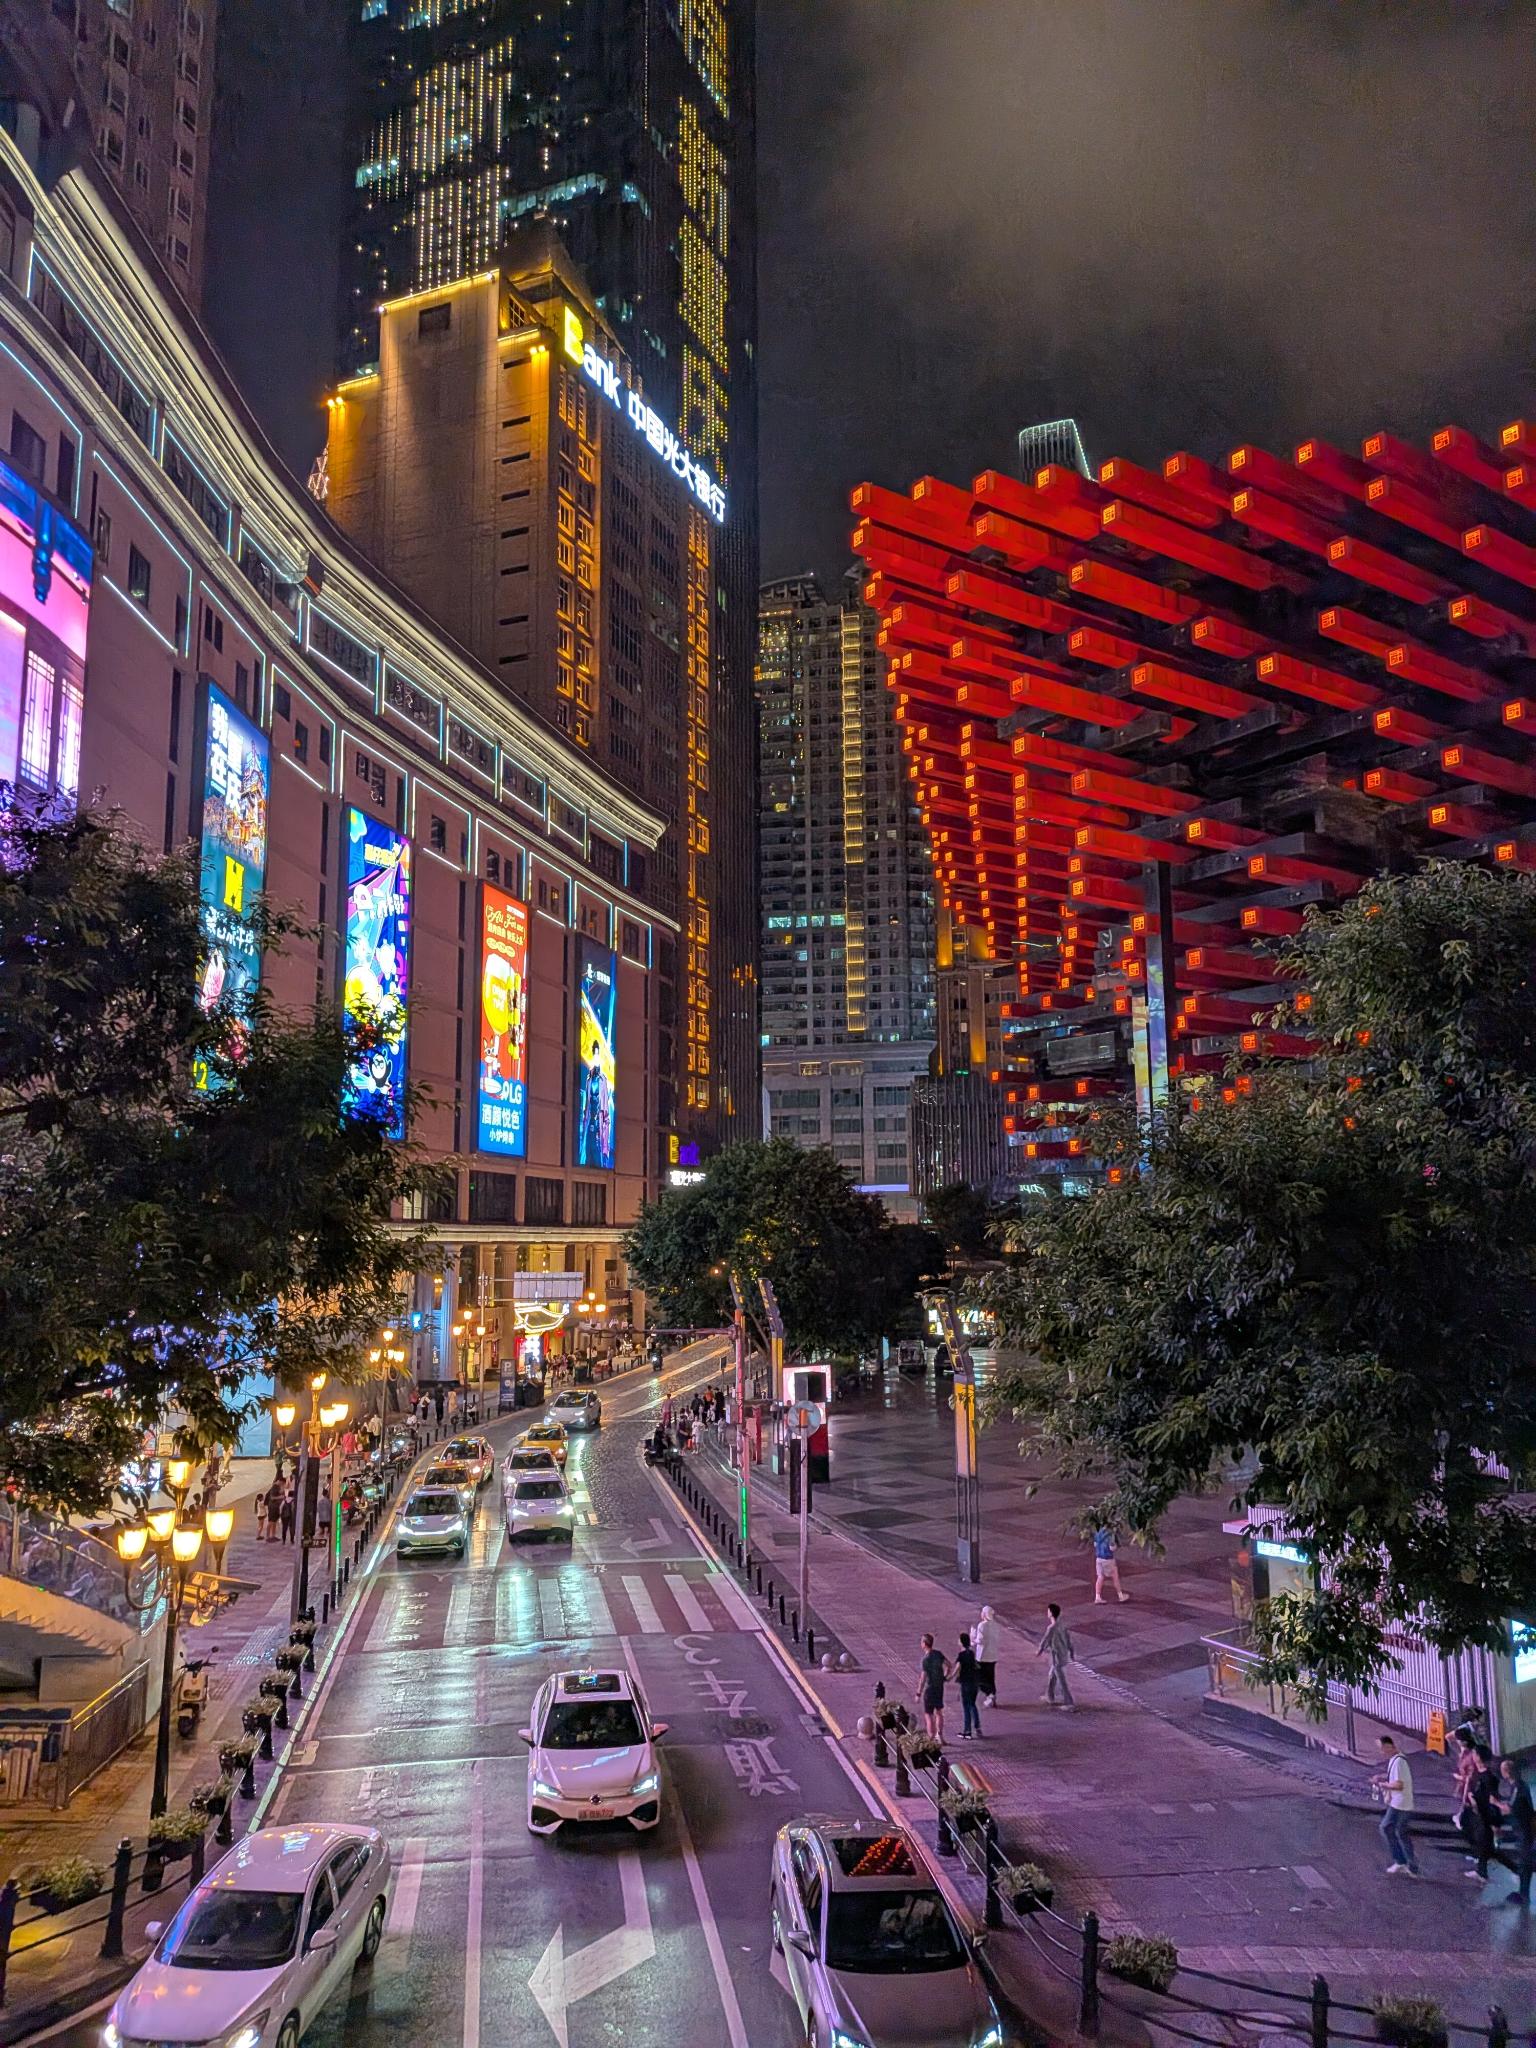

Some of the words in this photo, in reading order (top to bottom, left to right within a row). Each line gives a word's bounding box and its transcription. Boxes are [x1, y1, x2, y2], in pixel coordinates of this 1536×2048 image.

[563, 305, 621, 409] Bank
[628, 390, 727, 523] 中国光大银行
